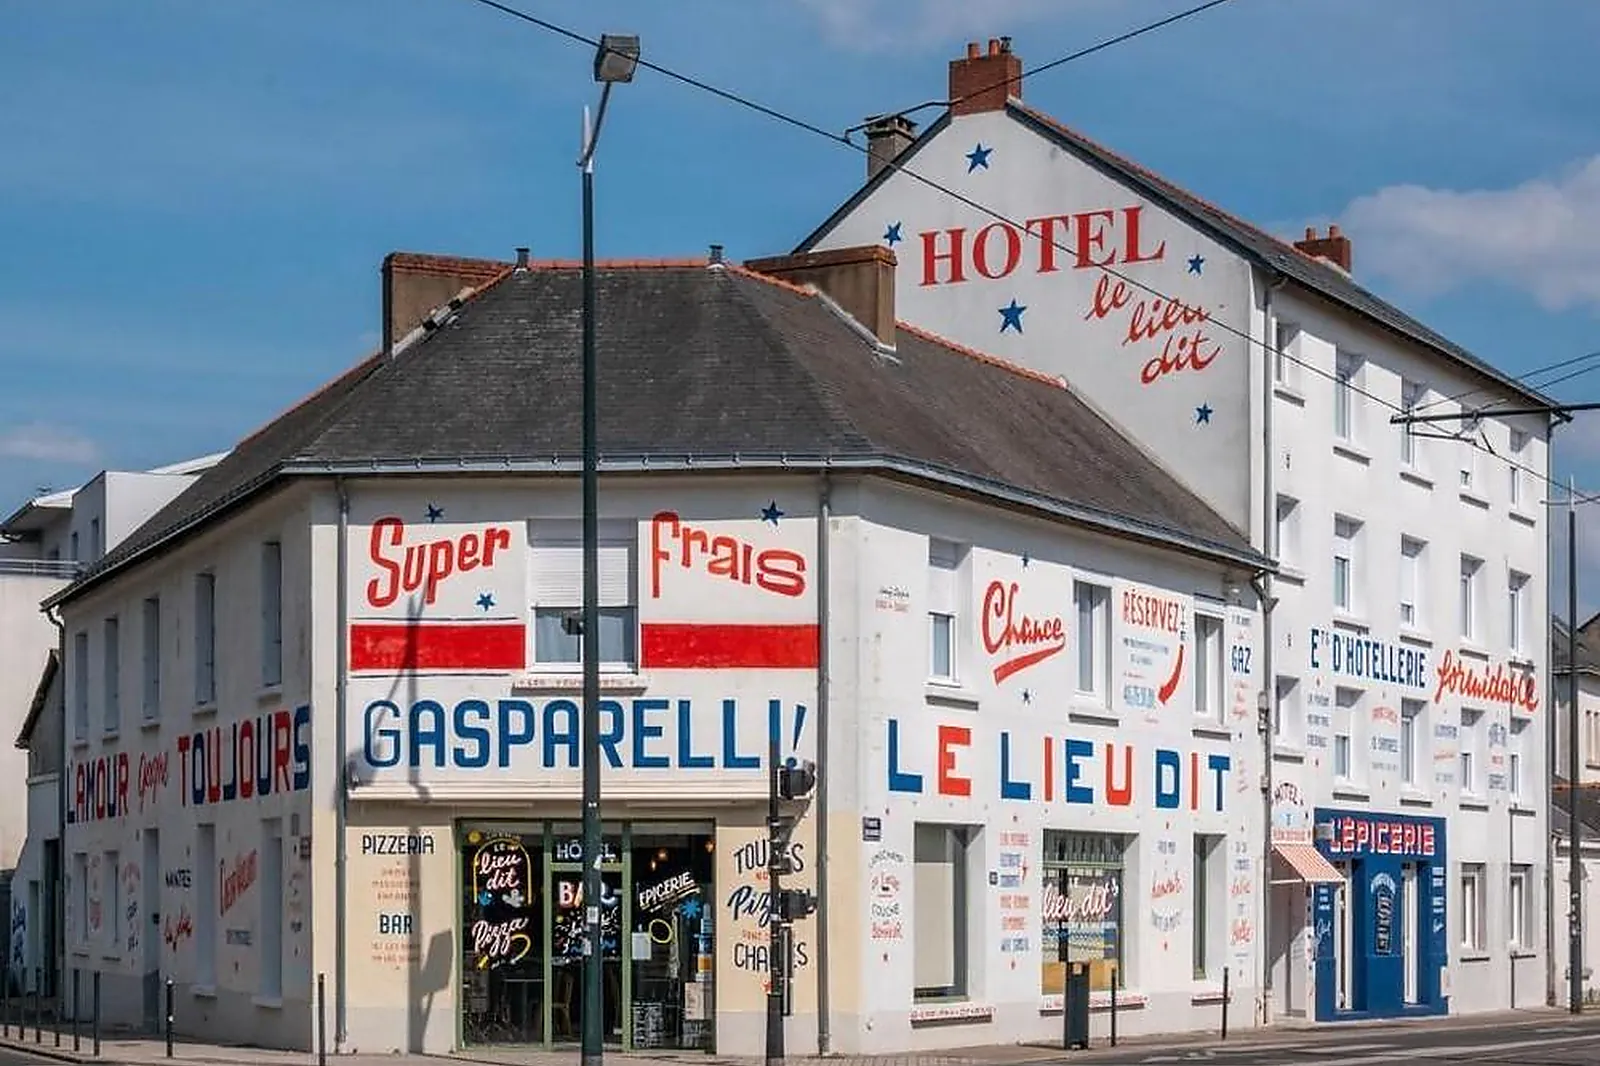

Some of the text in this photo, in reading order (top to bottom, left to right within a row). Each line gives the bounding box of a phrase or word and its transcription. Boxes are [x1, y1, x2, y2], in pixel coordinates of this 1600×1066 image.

[918, 206, 1166, 287] HOTEL
[1085, 274, 1131, 321] le
[1122, 299, 1212, 347] lieu
[1141, 330, 1221, 384] dit
[367, 516, 511, 608] Super
[982, 580, 1065, 655] Chance
[1122, 588, 1179, 632] RÉSERVEZ
[1231, 645, 1251, 674] GAZ
[1434, 649, 1539, 712] formidable
[66, 752, 129, 824] L'AMOUR
[178, 703, 311, 808] TOUJOURS
[887, 719, 1231, 811] LE LIEU DIT
[362, 834, 434, 855] PIZZERIA
[556, 839, 617, 860] HÔL
[733, 840, 804, 875] TOUS
[379, 914, 413, 935] BAR
